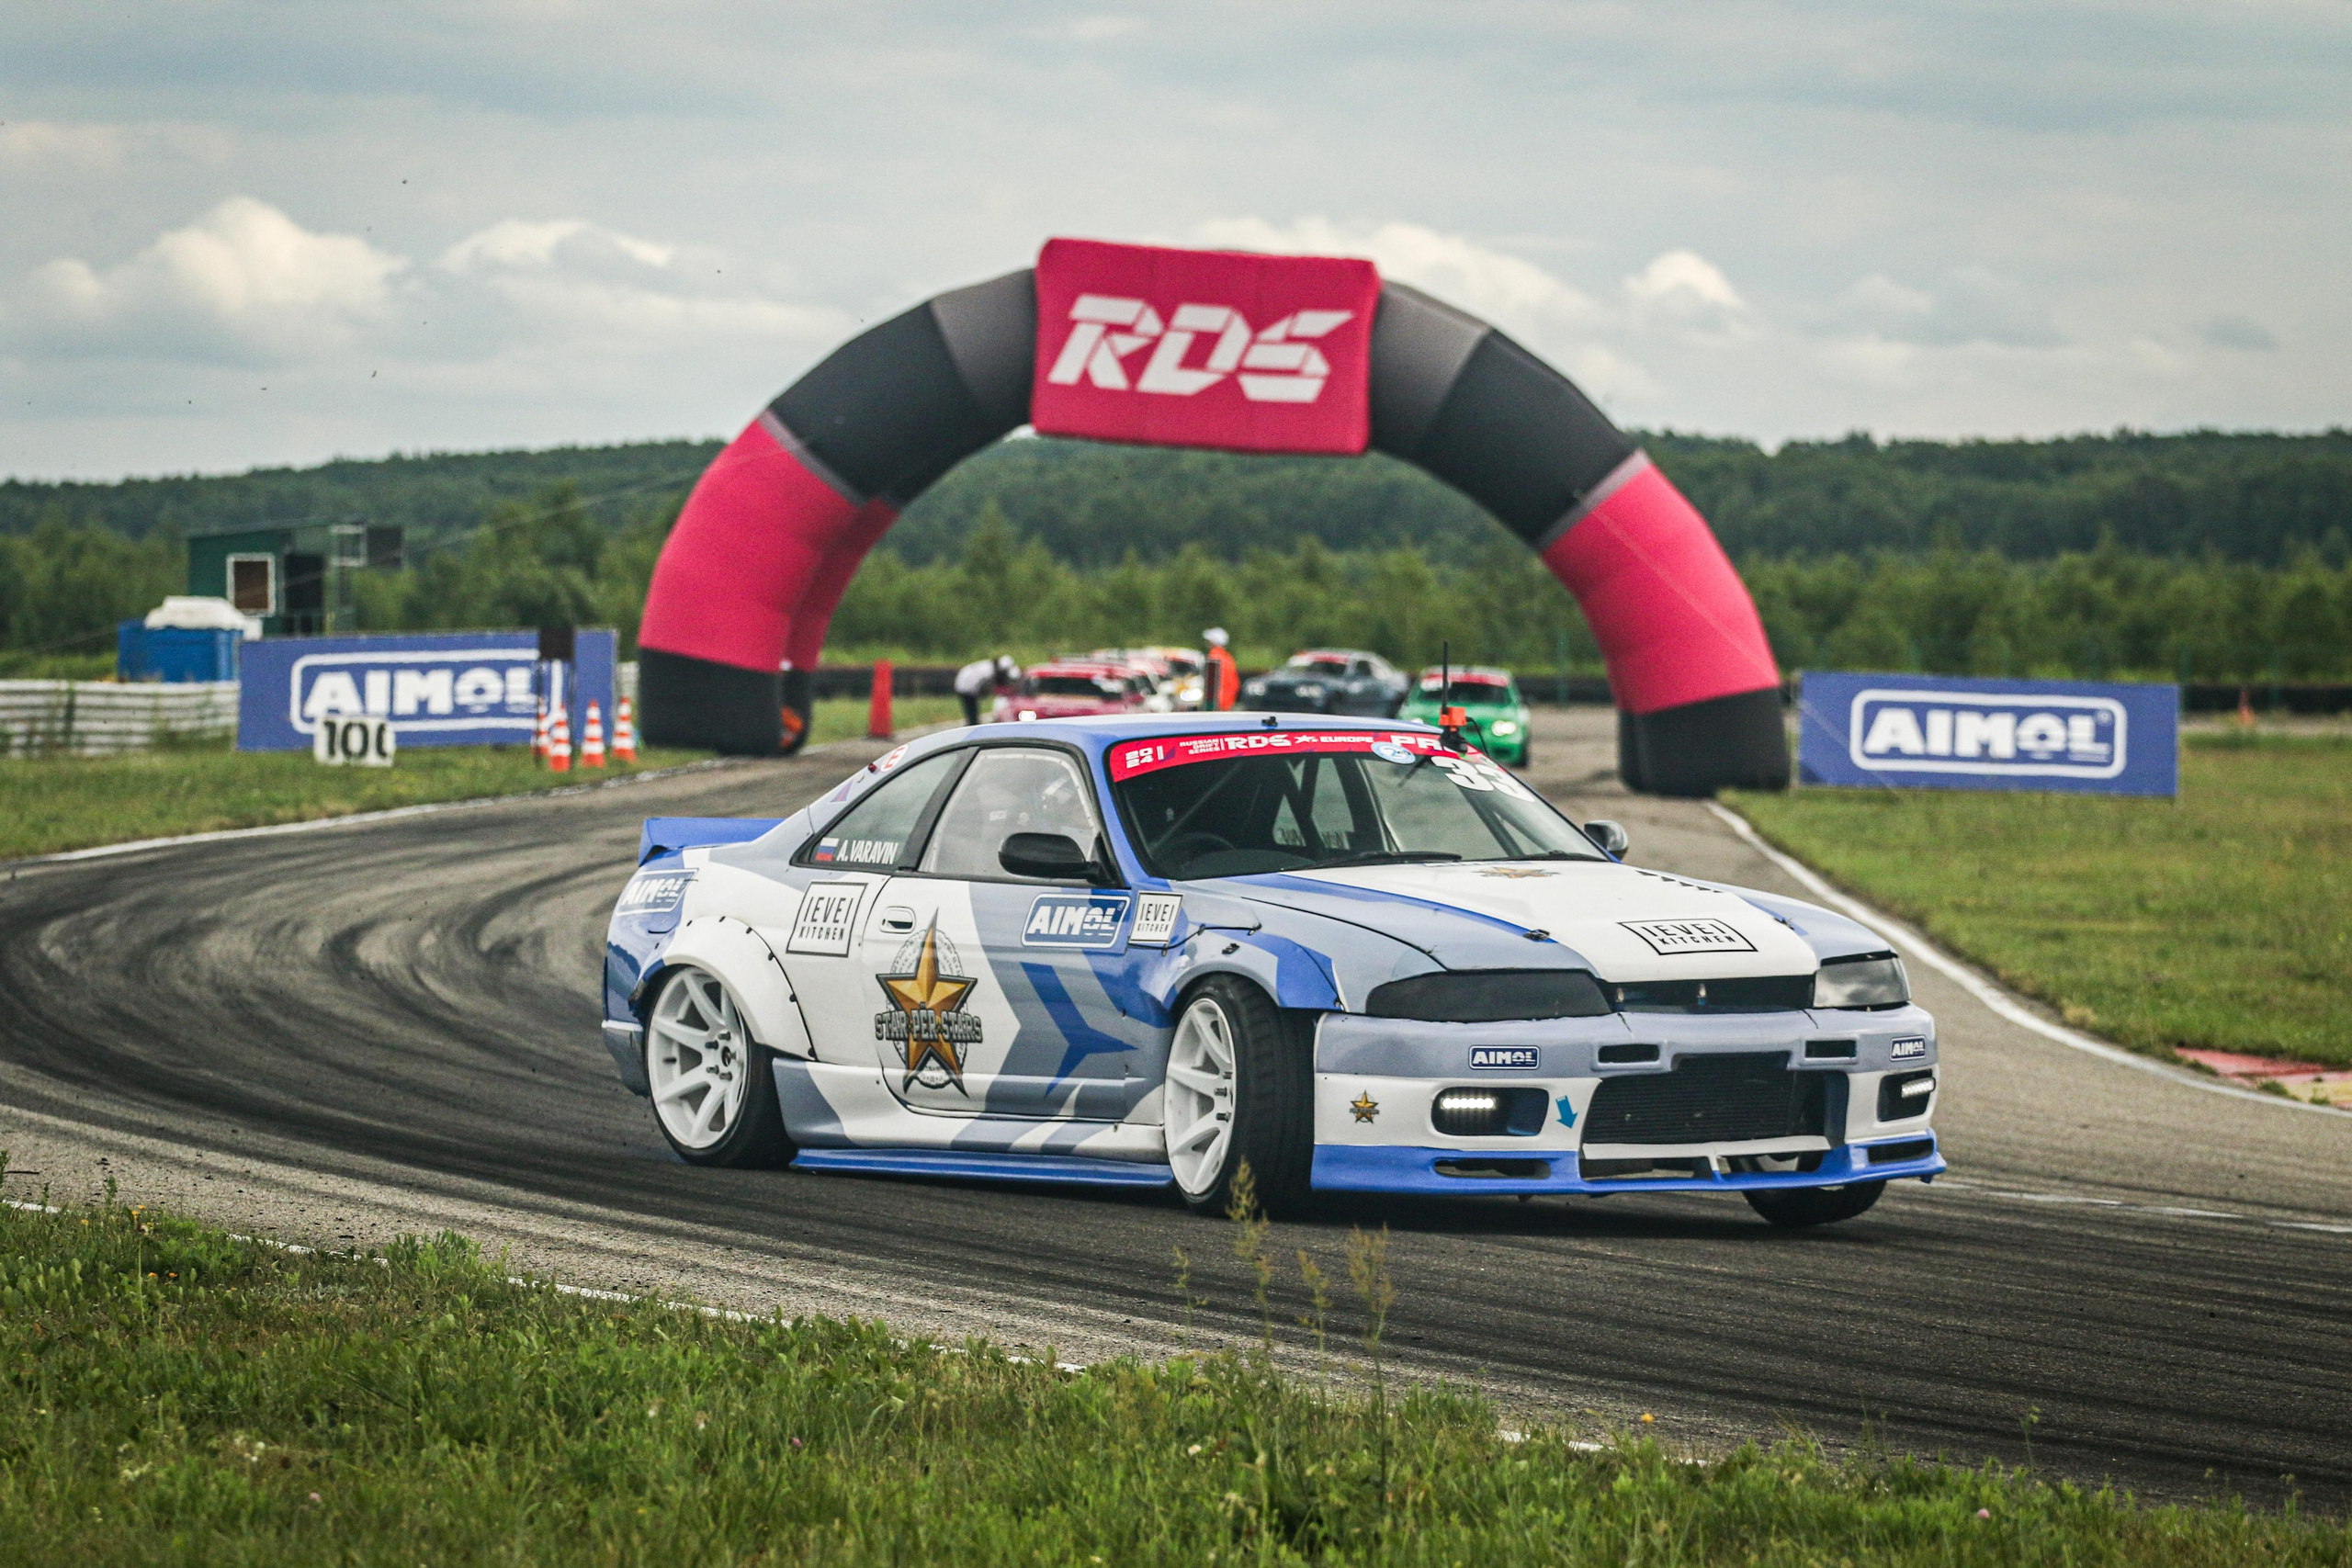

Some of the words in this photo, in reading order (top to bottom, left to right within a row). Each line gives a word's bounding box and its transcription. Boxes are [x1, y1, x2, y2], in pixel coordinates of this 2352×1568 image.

[1046, 292, 1356, 403] RDS
[302, 666, 539, 717] AIMOL
[1224, 734, 1292, 750] RDS
[1863, 707, 2111, 761] AIMOL
[1179, 739, 1219, 748] RUSSIAN
[1125, 746, 1154, 761] 20
[1125, 755, 1154, 769] 24
[1430, 756, 1535, 802] 33
[622, 877, 684, 905] AIMOL
[1026, 905, 1116, 936] AIMOL
[798, 926, 845, 941] KITCHEN
[1657, 935, 1736, 945] KITCHEN
[875, 1010, 909, 1041] STAR
[910, 1009, 938, 1042] PER
[940, 1010, 983, 1043] STARS
[1891, 1041, 1925, 1056] AIMOL
[1472, 1051, 1536, 1065] AIMOL
